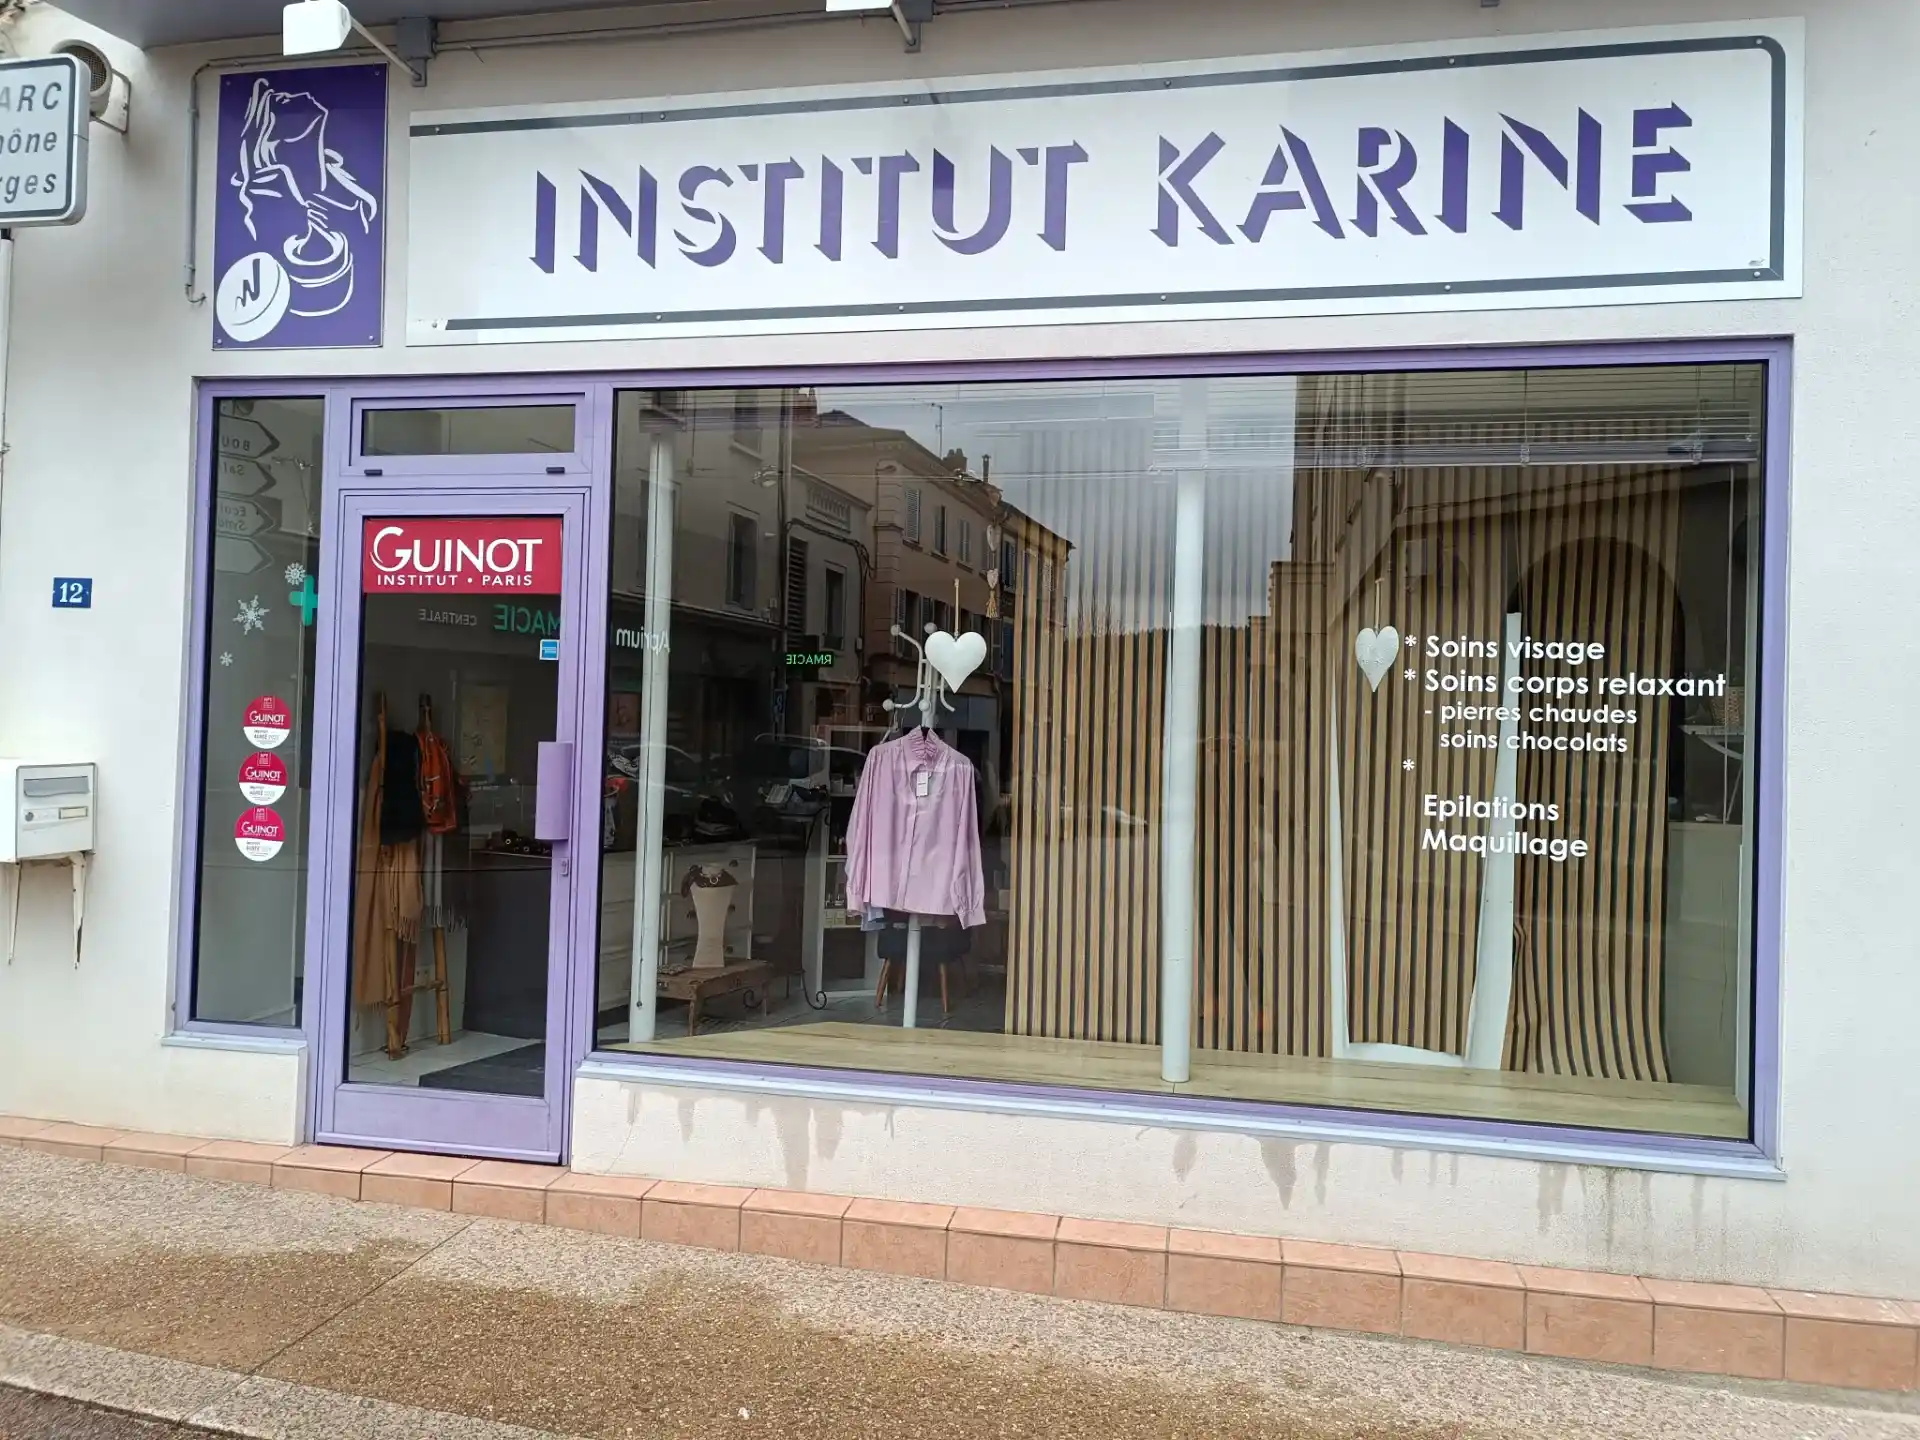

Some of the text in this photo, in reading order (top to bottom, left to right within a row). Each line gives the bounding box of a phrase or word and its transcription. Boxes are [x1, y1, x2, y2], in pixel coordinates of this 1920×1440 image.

[0, 173, 57, 204] ges
[529, 100, 1693, 274] INSTITUT KARINE
[370, 526, 543, 573] GUINOT
[59, 582, 83, 603] 12
[377, 574, 533, 586] INSTITUT PARIS
[1425, 635, 1605, 665] Soins visage
[1425, 669, 1726, 699] Soins corps relaxant
[1441, 701, 1637, 724] pierres chaudes
[1440, 730, 1628, 752] soins chocolats
[1424, 794, 1560, 821] Epilations
[1422, 829, 1588, 862] Maquillage
